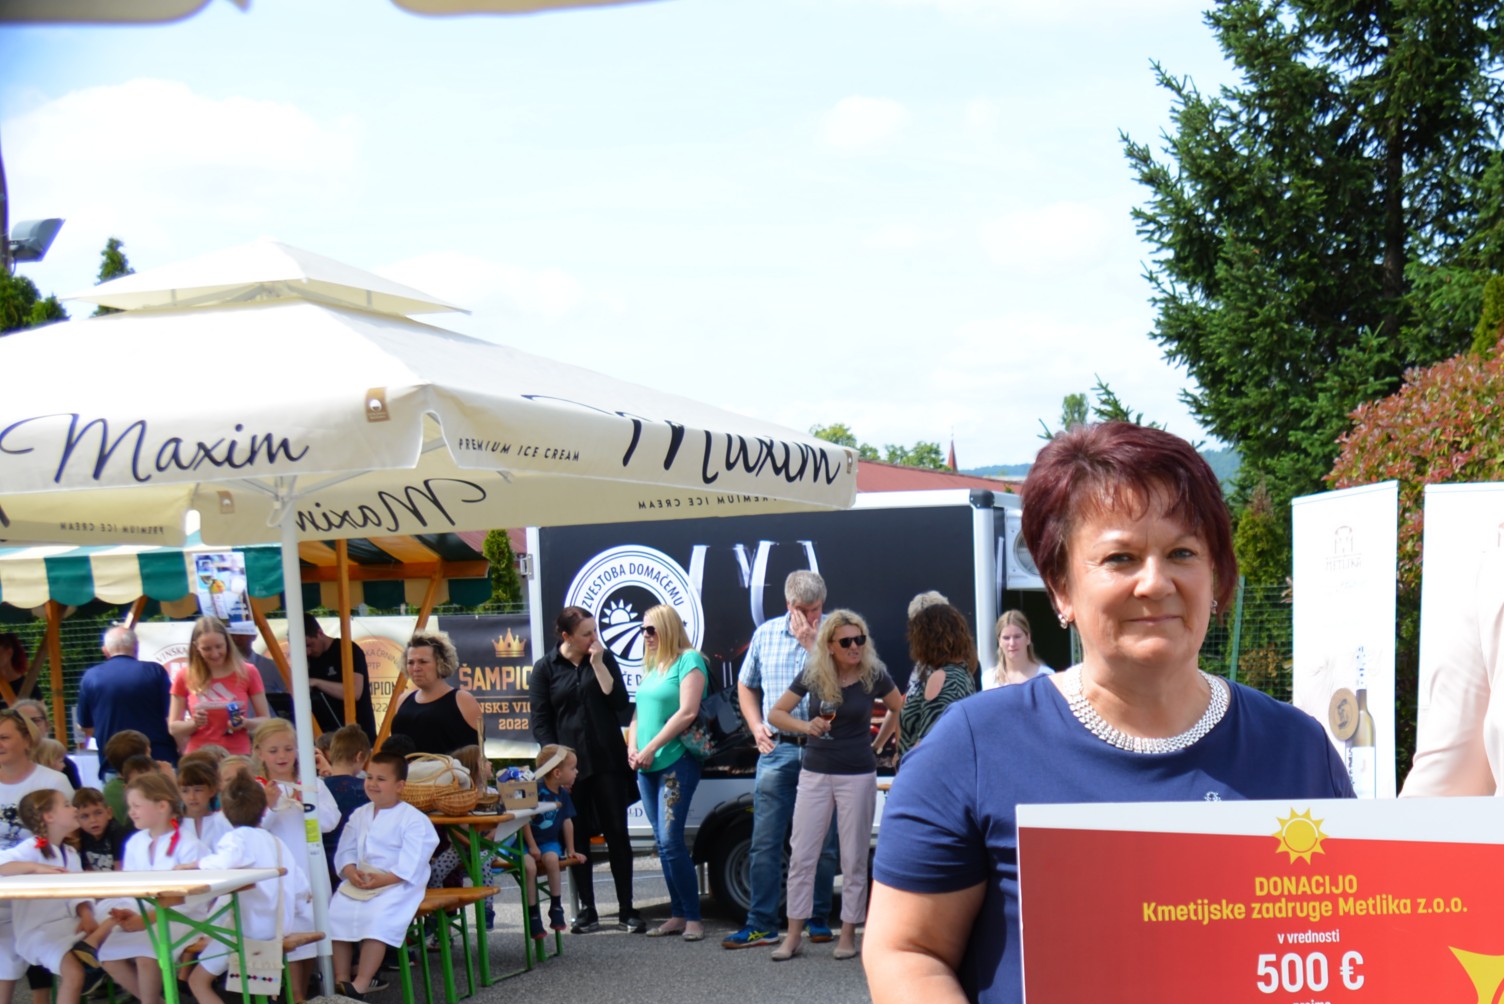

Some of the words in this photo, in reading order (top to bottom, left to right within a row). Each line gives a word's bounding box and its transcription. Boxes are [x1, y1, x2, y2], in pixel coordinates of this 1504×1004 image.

[0, 412, 310, 483] Maxim
[458, 437, 511, 455] PREMIUM
[517, 443, 540, 458] ICE
[544, 446, 581, 463] CREAM
[581, 563, 627, 610] ZVESTOBA
[629, 562, 685, 608] DOMAČEMU
[459, 663, 533, 691] ŠAMPIO
[498, 718, 530, 731] 2022
[1254, 874, 1359, 897] DONACIJO
[1142, 898, 1247, 926] Kmetijske
[1251, 897, 1334, 923] zadruge
[1338, 893, 1412, 917] Metlika
[1416, 897, 1469, 914] z.o.o.
[1277, 932, 1286, 945] v
[1287, 929, 1341, 945] vrednosti
[1256, 951, 1330, 994] 500
[1338, 949, 1366, 992] €
